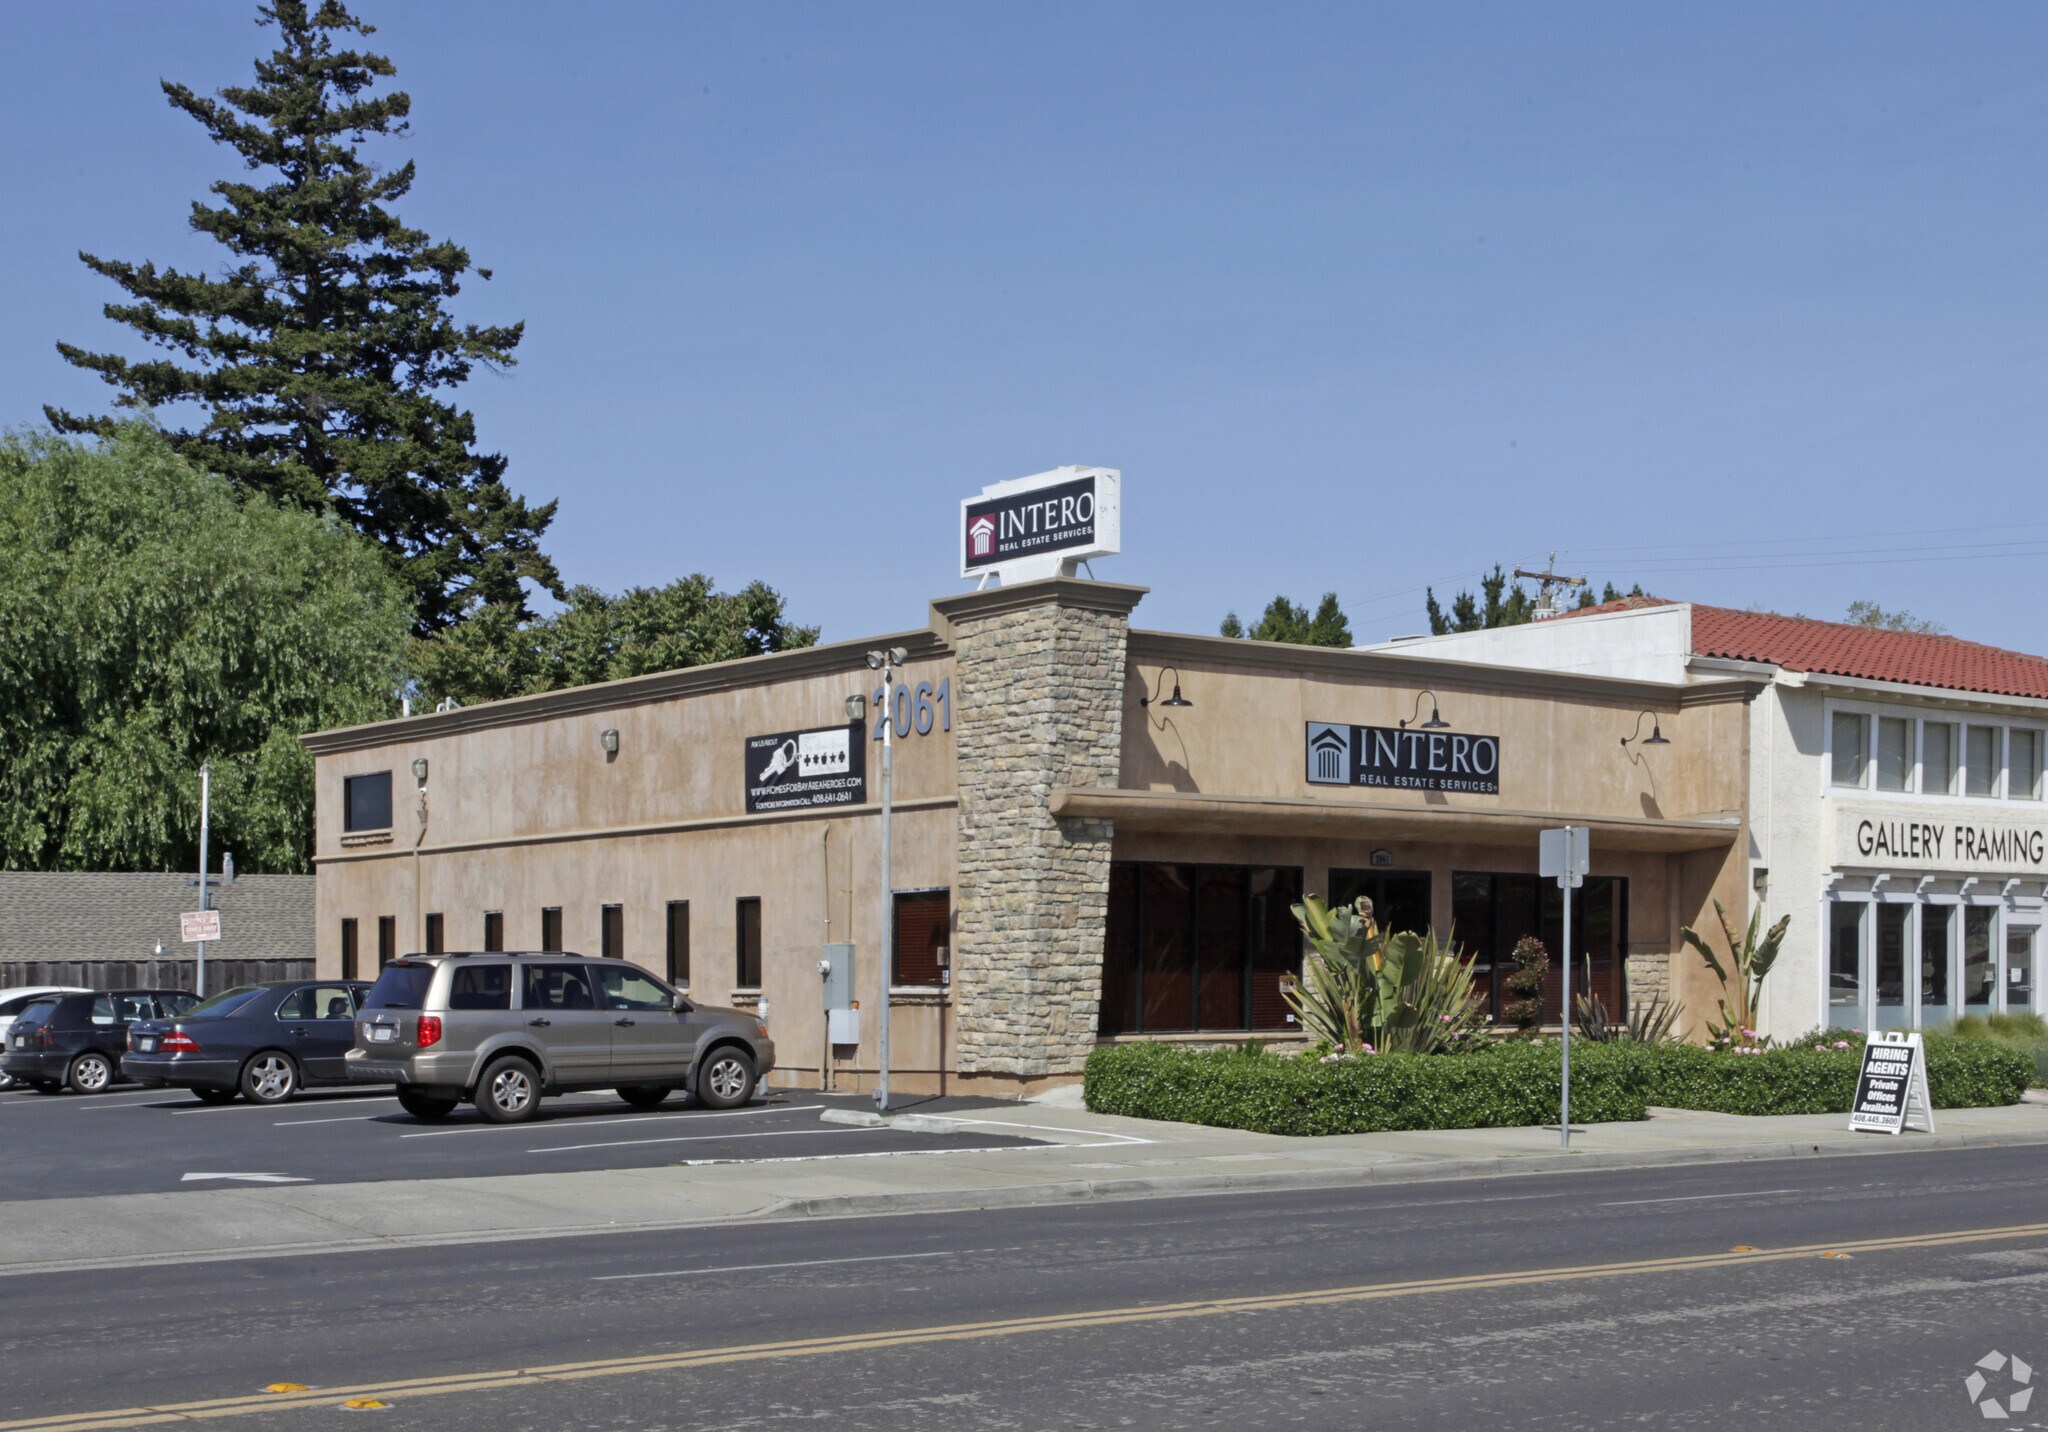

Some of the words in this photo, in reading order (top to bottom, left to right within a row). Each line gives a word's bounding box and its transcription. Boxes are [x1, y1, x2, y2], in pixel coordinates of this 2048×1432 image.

[1000, 492, 1095, 540] INTERO
[1000, 543, 1019, 552] REAL
[1022, 534, 1050, 547] ESTATE
[873, 676, 950, 741] 2061
[1360, 728, 1497, 775] INTERO
[1360, 774, 1389, 785] REAL
[1394, 776, 1435, 788] ESTATE
[1440, 779, 1493, 792] SERVICES
[1857, 820, 1944, 859] GALLERY
[1955, 826, 2044, 864] FRAMING
[1871, 1047, 1909, 1062] HIRING
[1866, 1061, 1909, 1076] AGENTS
[1869, 1079, 1899, 1091] Private
[1867, 1091, 1896, 1102] Offices
[1860, 1101, 1898, 1114] Available
